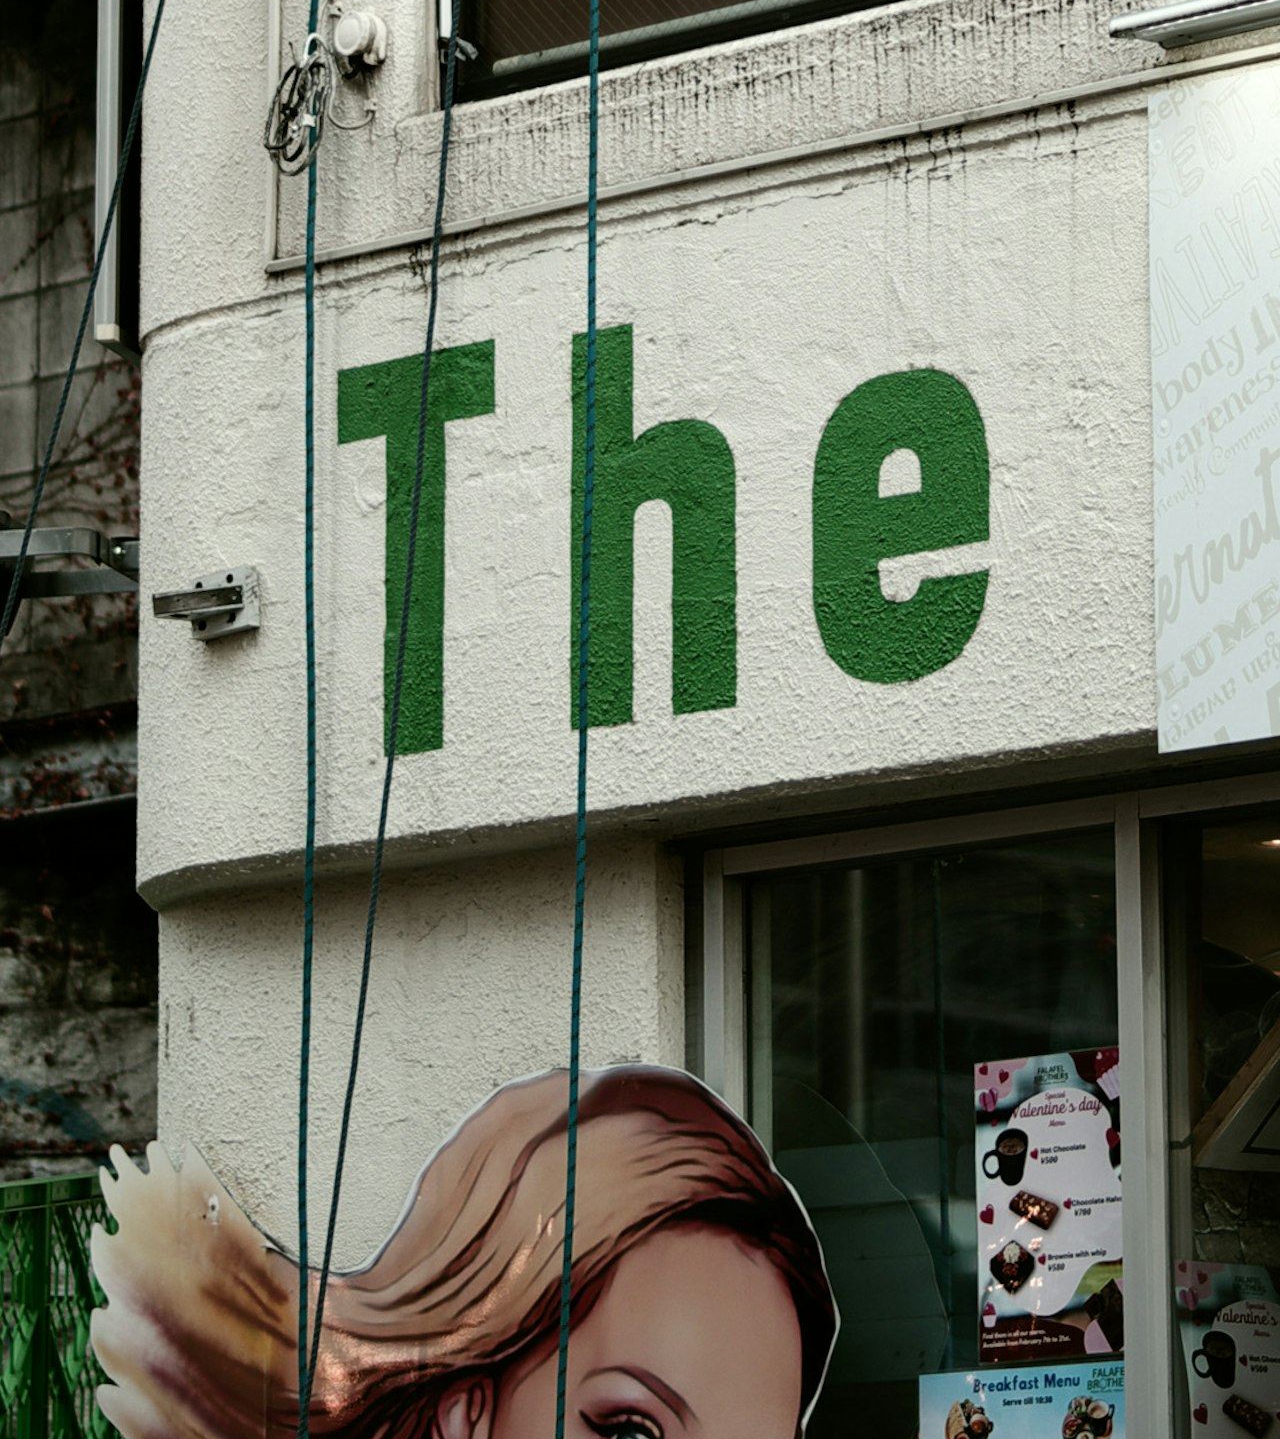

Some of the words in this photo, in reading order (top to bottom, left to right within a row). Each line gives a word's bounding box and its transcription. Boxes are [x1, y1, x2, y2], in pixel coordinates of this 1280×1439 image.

[337, 322, 992, 758] The
[1079, 1095, 1104, 1117] day
[972, 1374, 1040, 1394] Breakfast
[1044, 1372, 1081, 1389] Menu
